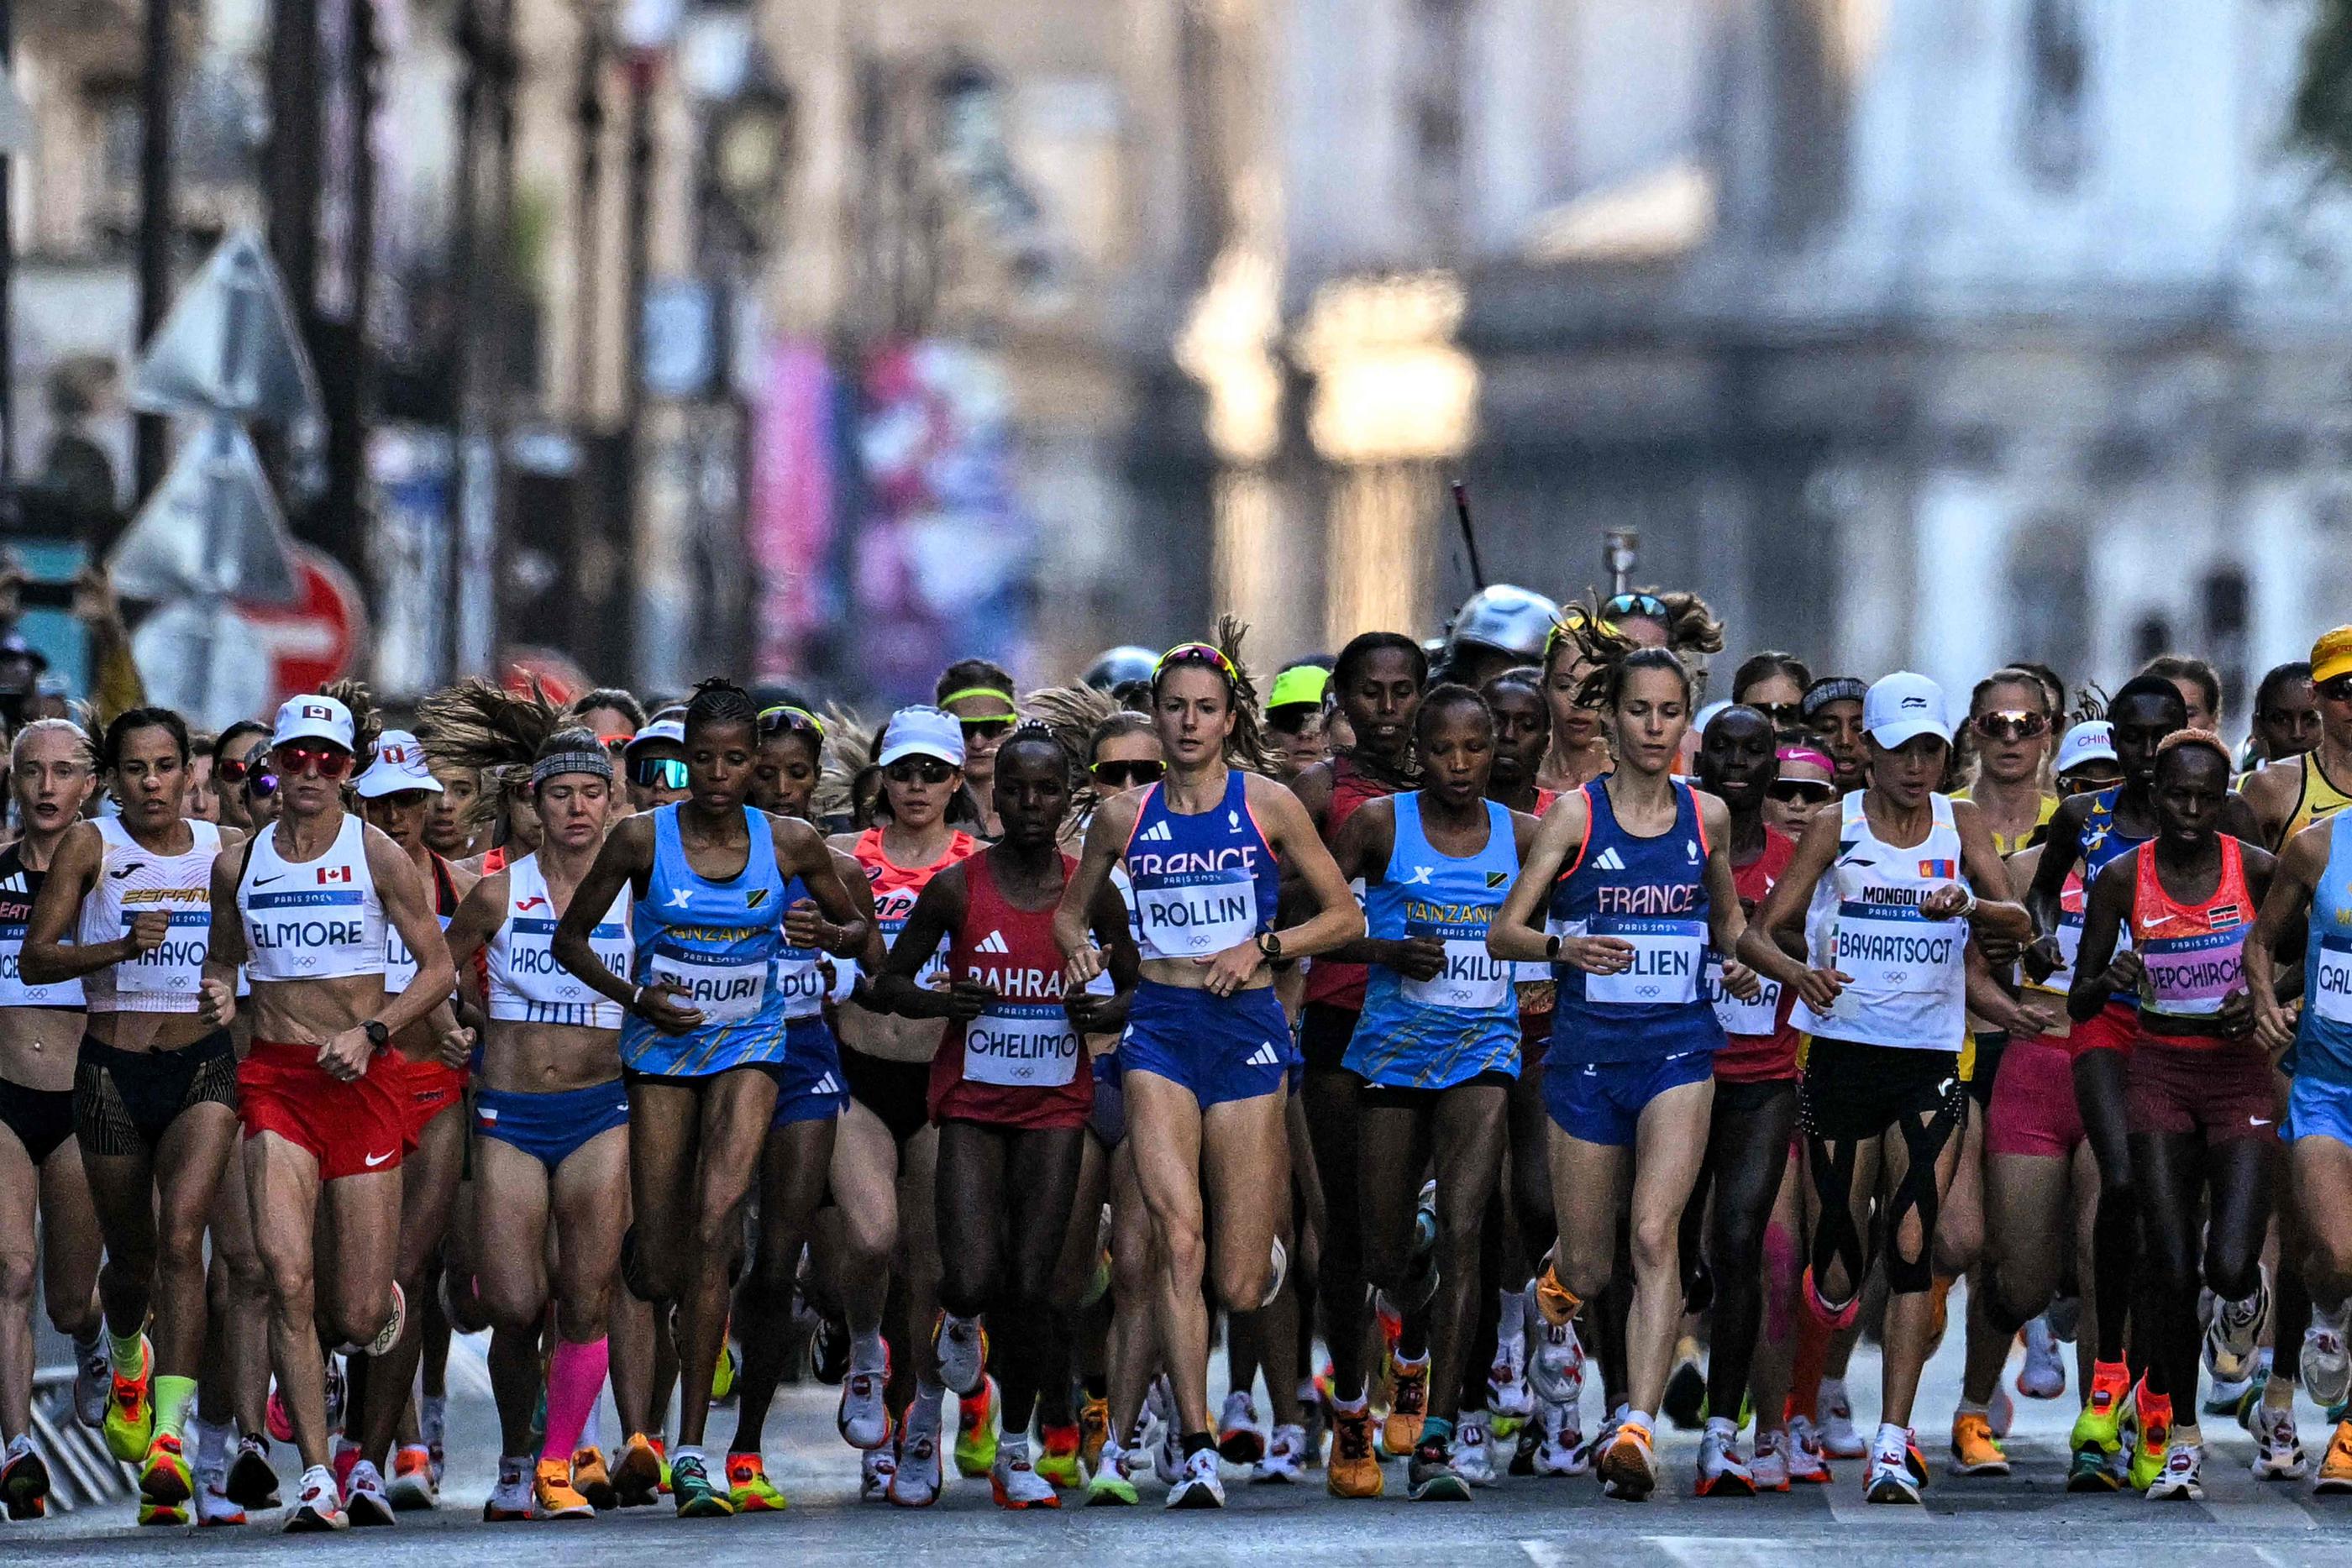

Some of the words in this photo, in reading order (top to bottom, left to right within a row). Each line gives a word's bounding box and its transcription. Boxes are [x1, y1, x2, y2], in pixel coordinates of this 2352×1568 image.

[1164, 876, 1191, 884] PARIS
[305, 894, 332, 902] 2024
[1598, 884, 1698, 914] FRANCE
[1150, 895, 1247, 927] ROLLIN
[1868, 908, 1898, 917] PARIS
[1436, 928, 1464, 936] PARIS
[1618, 923, 1647, 931] PARIS
[1651, 924, 1677, 932] 2024
[252, 921, 362, 948] ELMORE
[1839, 931, 1953, 964] BAYARTSOGT
[2171, 940, 2201, 950] PARIS
[2204, 935, 2230, 946] 2024
[997, 1006, 1026, 1015] PARIS
[1030, 1008, 1056, 1016] 2024
[969, 1029, 1077, 1058] CHELIMO
